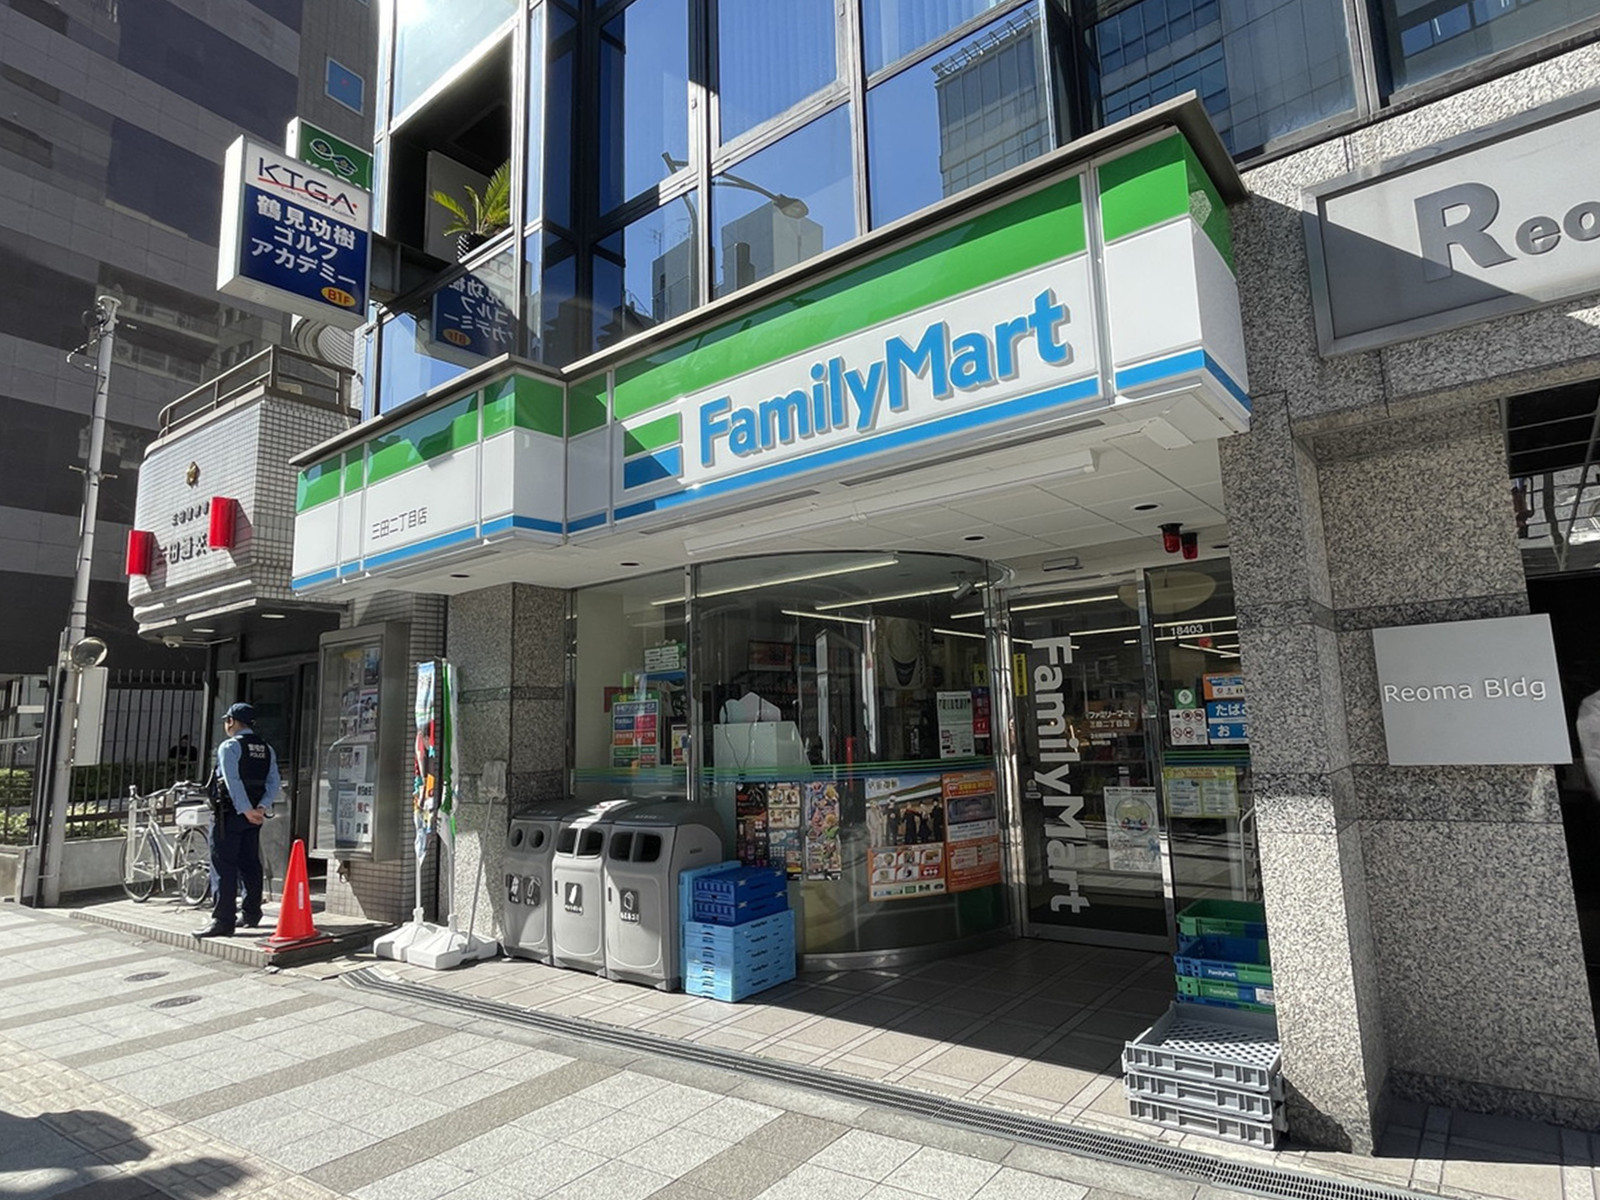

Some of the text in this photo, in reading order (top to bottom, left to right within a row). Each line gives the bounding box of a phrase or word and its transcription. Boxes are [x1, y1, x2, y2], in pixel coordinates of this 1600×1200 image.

[259, 157, 356, 215] KTGA
[256, 194, 356, 250] 鶴見功樹
[1413, 182, 1600, 283] Reo
[274, 226, 338, 260] ゴルフ
[251, 237, 357, 285] アカデミー
[327, 288, 351, 307] B1F
[700, 288, 1071, 468] FamilyMart
[372, 506, 428, 540] 三田二丁目店
[1170, 624, 1204, 636] 18403
[1383, 676, 1547, 703] Reoma Bldg
[1032, 636, 1091, 914] FamilyMart
[1208, 968, 1236, 978] FamilyMart
[1210, 988, 1238, 998] FamilyMart
